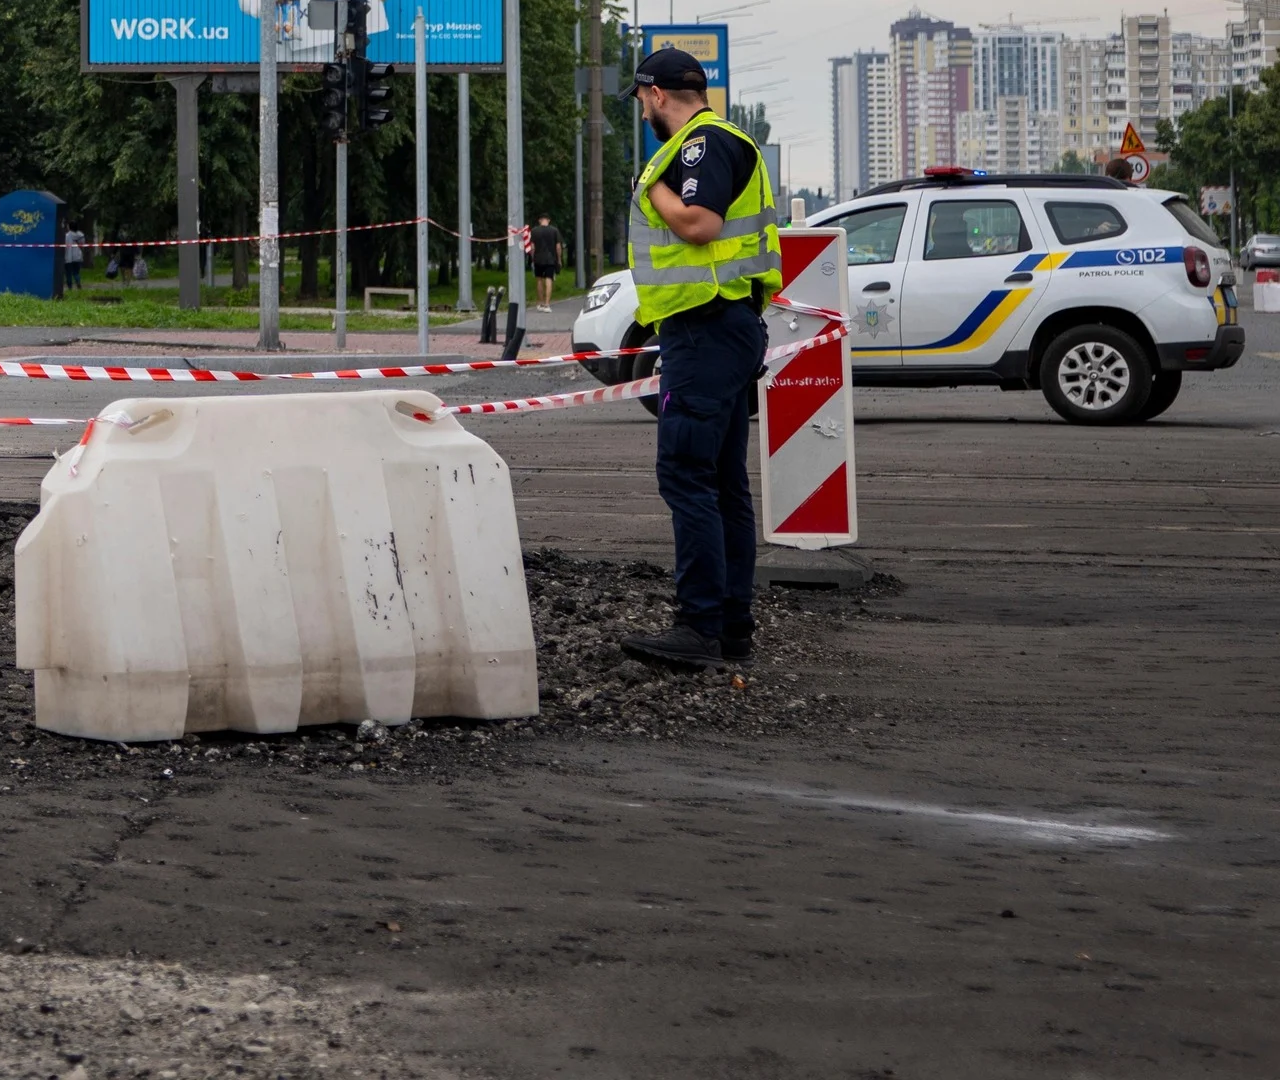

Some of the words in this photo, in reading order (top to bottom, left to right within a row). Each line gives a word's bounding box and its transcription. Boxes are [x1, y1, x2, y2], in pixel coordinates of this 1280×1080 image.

[111, 18, 229, 40] WORK.ua
[410, 22, 444, 32] Атур
[446, 22, 482, 30] Михно
[1138, 248, 1166, 263] 102
[1079, 270, 1112, 278] PATROL
[1114, 269, 1145, 277] POLICE
